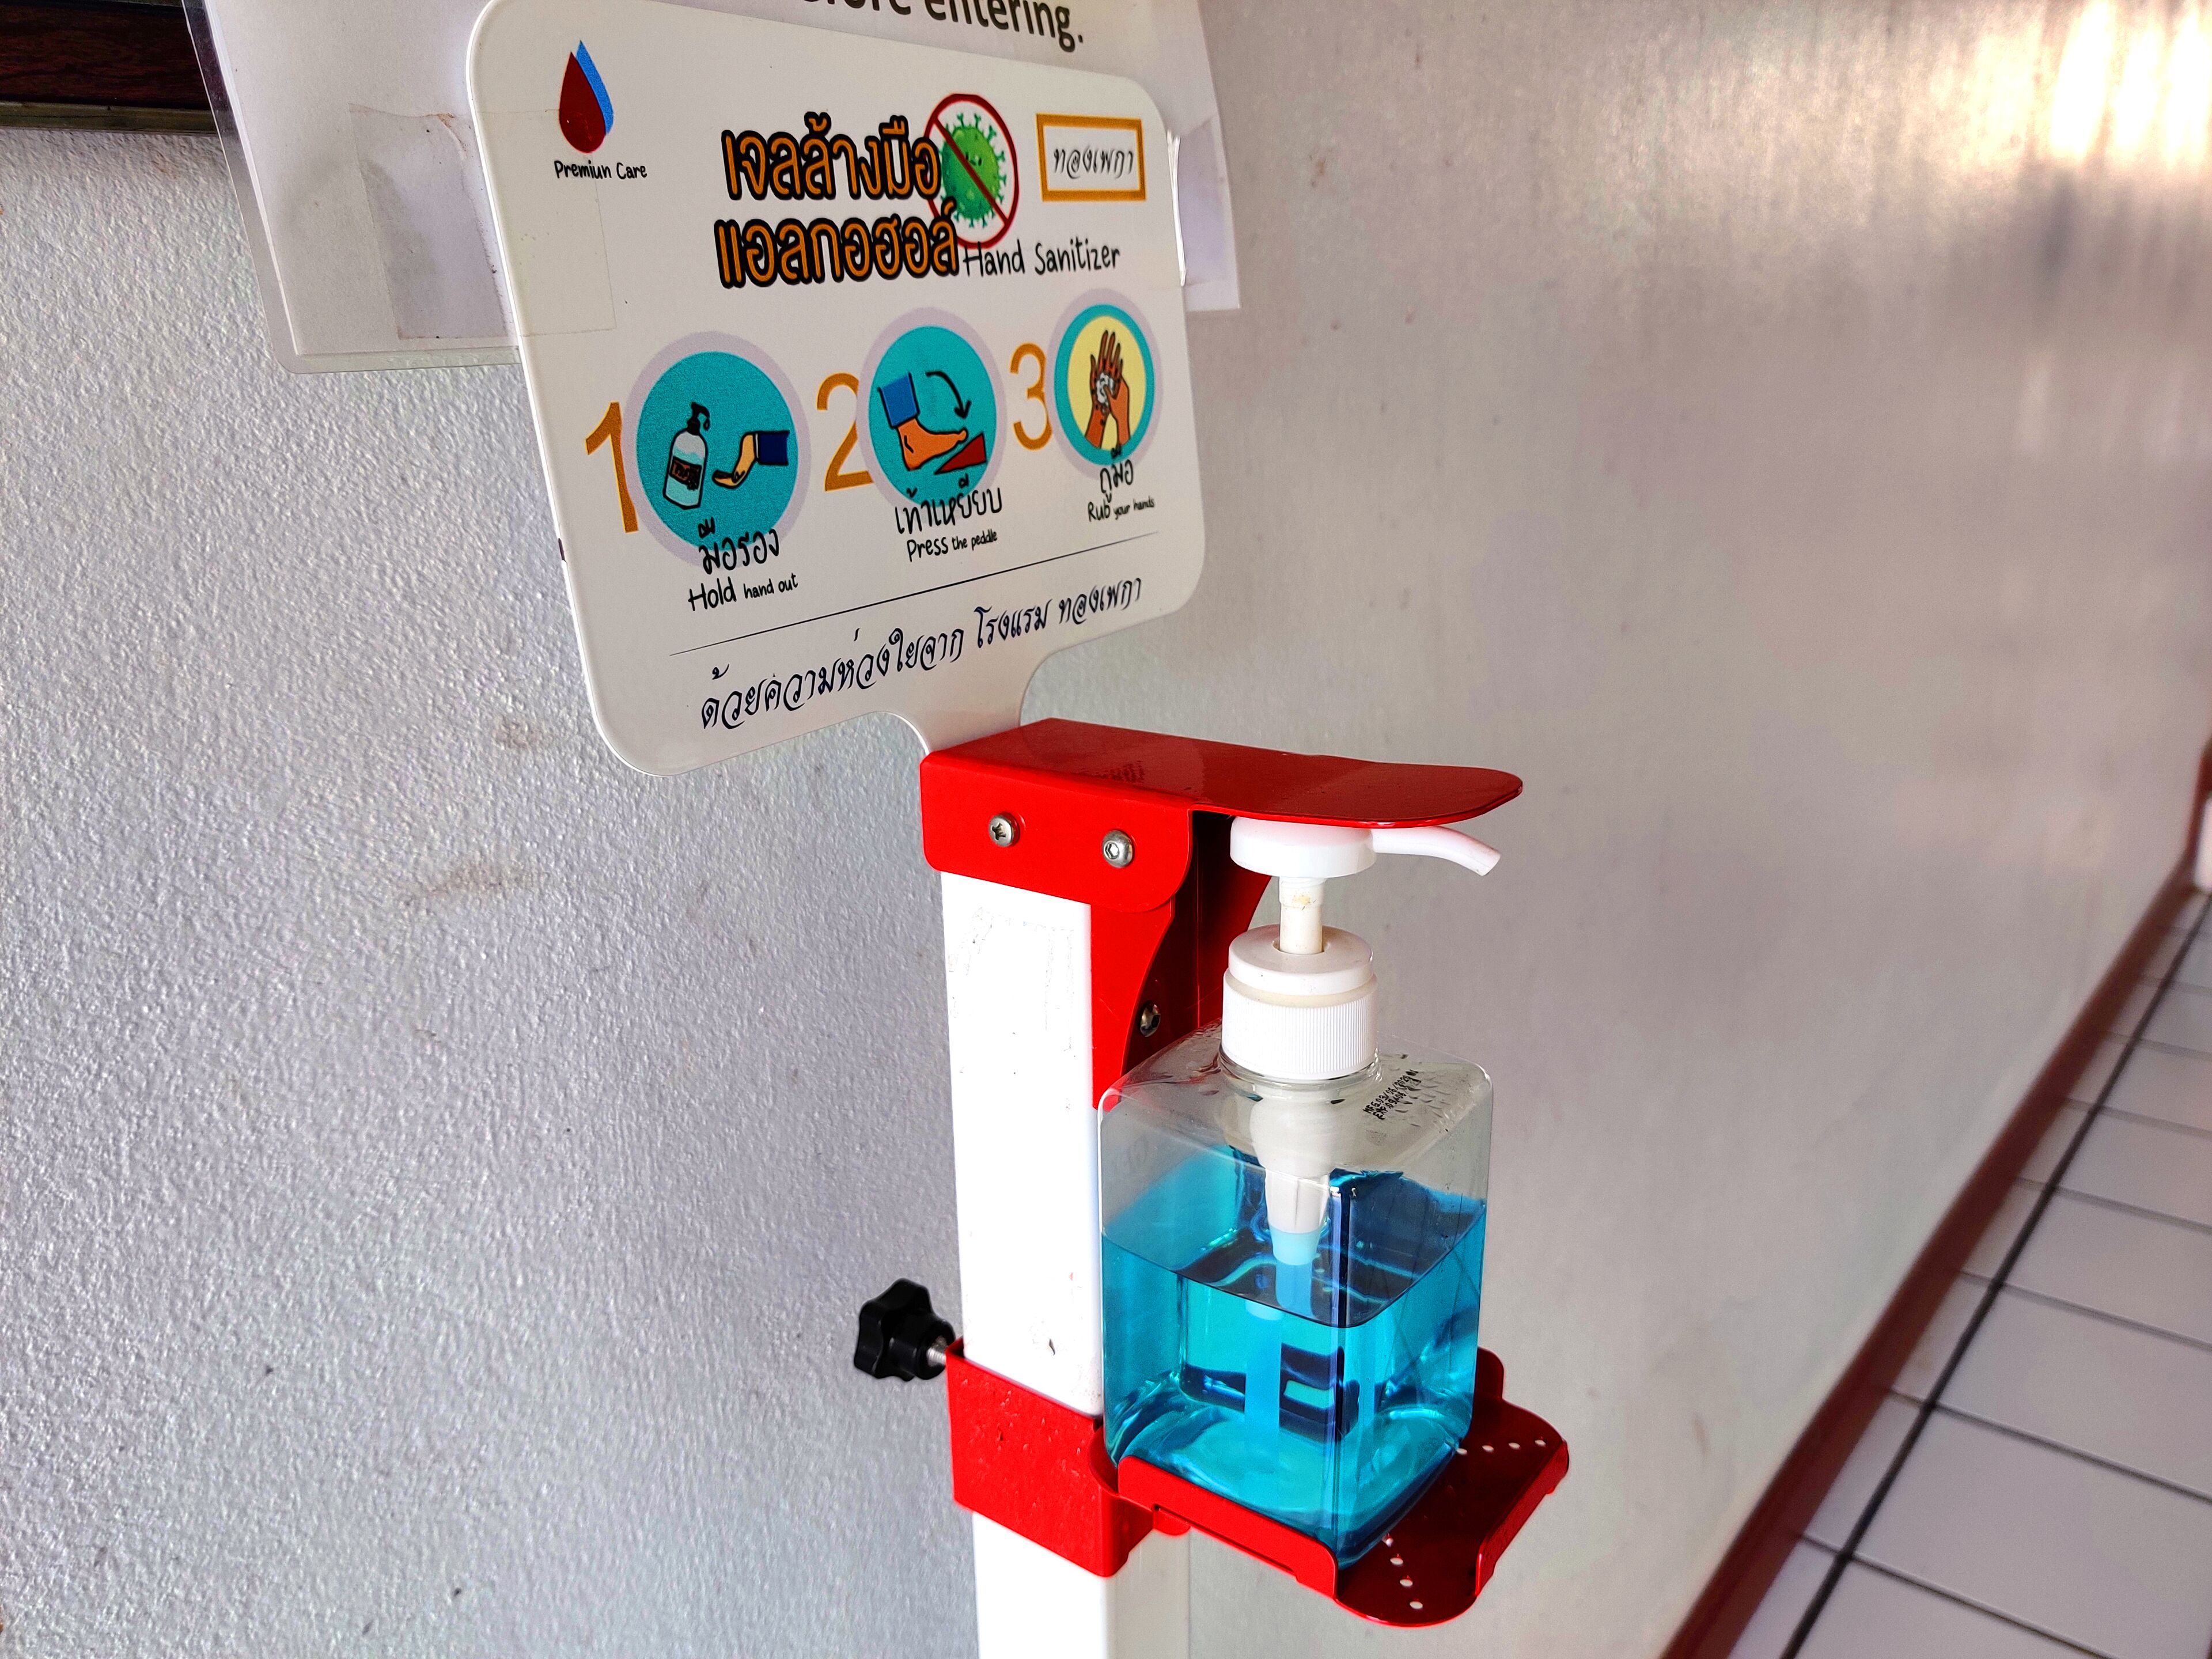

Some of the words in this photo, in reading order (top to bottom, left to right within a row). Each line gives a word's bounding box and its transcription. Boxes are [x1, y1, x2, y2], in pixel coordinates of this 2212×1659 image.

[925, 0, 1084, 52] entering.
[554, 159, 612, 179] Premiun
[616, 162, 647, 180] Care
[721, 111, 941, 200] เจลล้างมือ
[1054, 145, 1133, 179] ทองเพกา
[714, 196, 960, 288] แอลกอฮอล์
[963, 238, 1025, 277] Hand
[1035, 236, 1120, 275] Sanitizer
[1009, 342, 1052, 451] 3
[817, 373, 873, 491] 2
[585, 402, 639, 533] 1
[895, 473, 1002, 535] เท้าเหยียบ
[1088, 499, 1110, 522] Rub
[1113, 505, 1130, 520] your
[1132, 495, 1155, 510] hands
[698, 517, 779, 575] มือรอง
[907, 537, 949, 562] Press
[952, 536, 968, 550] the
[971, 528, 998, 551] peddle
[688, 576, 737, 611] Hold
[743, 578, 774, 599] hand
[778, 573, 798, 593] out
[974, 599, 1052, 649] โรงแรม
